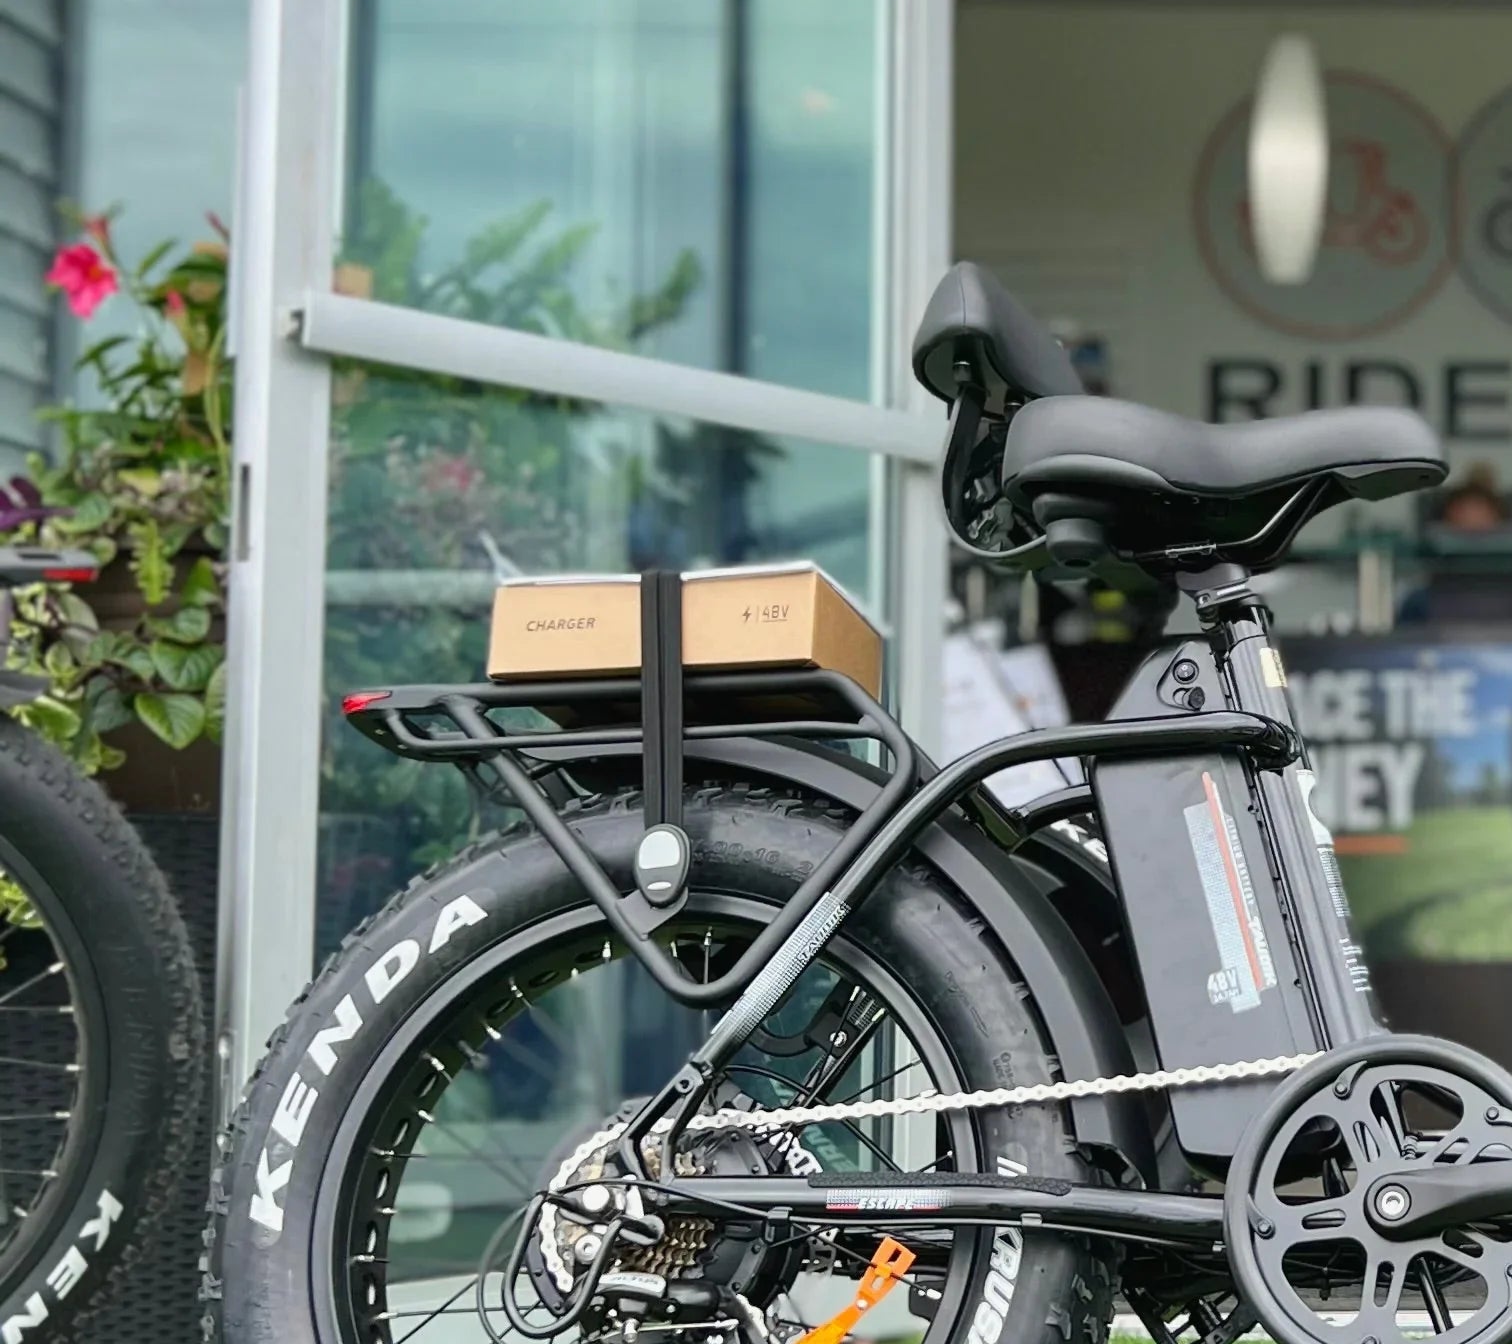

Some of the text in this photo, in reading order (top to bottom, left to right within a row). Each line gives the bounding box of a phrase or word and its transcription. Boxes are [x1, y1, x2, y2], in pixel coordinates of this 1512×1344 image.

[762, 605, 790, 620] 48V
[526, 617, 597, 632] CHARGER
[1378, 668, 1478, 736] THE
[250, 894, 488, 1231] KENDA
[857, 1197, 917, 1210] ESCAPE
